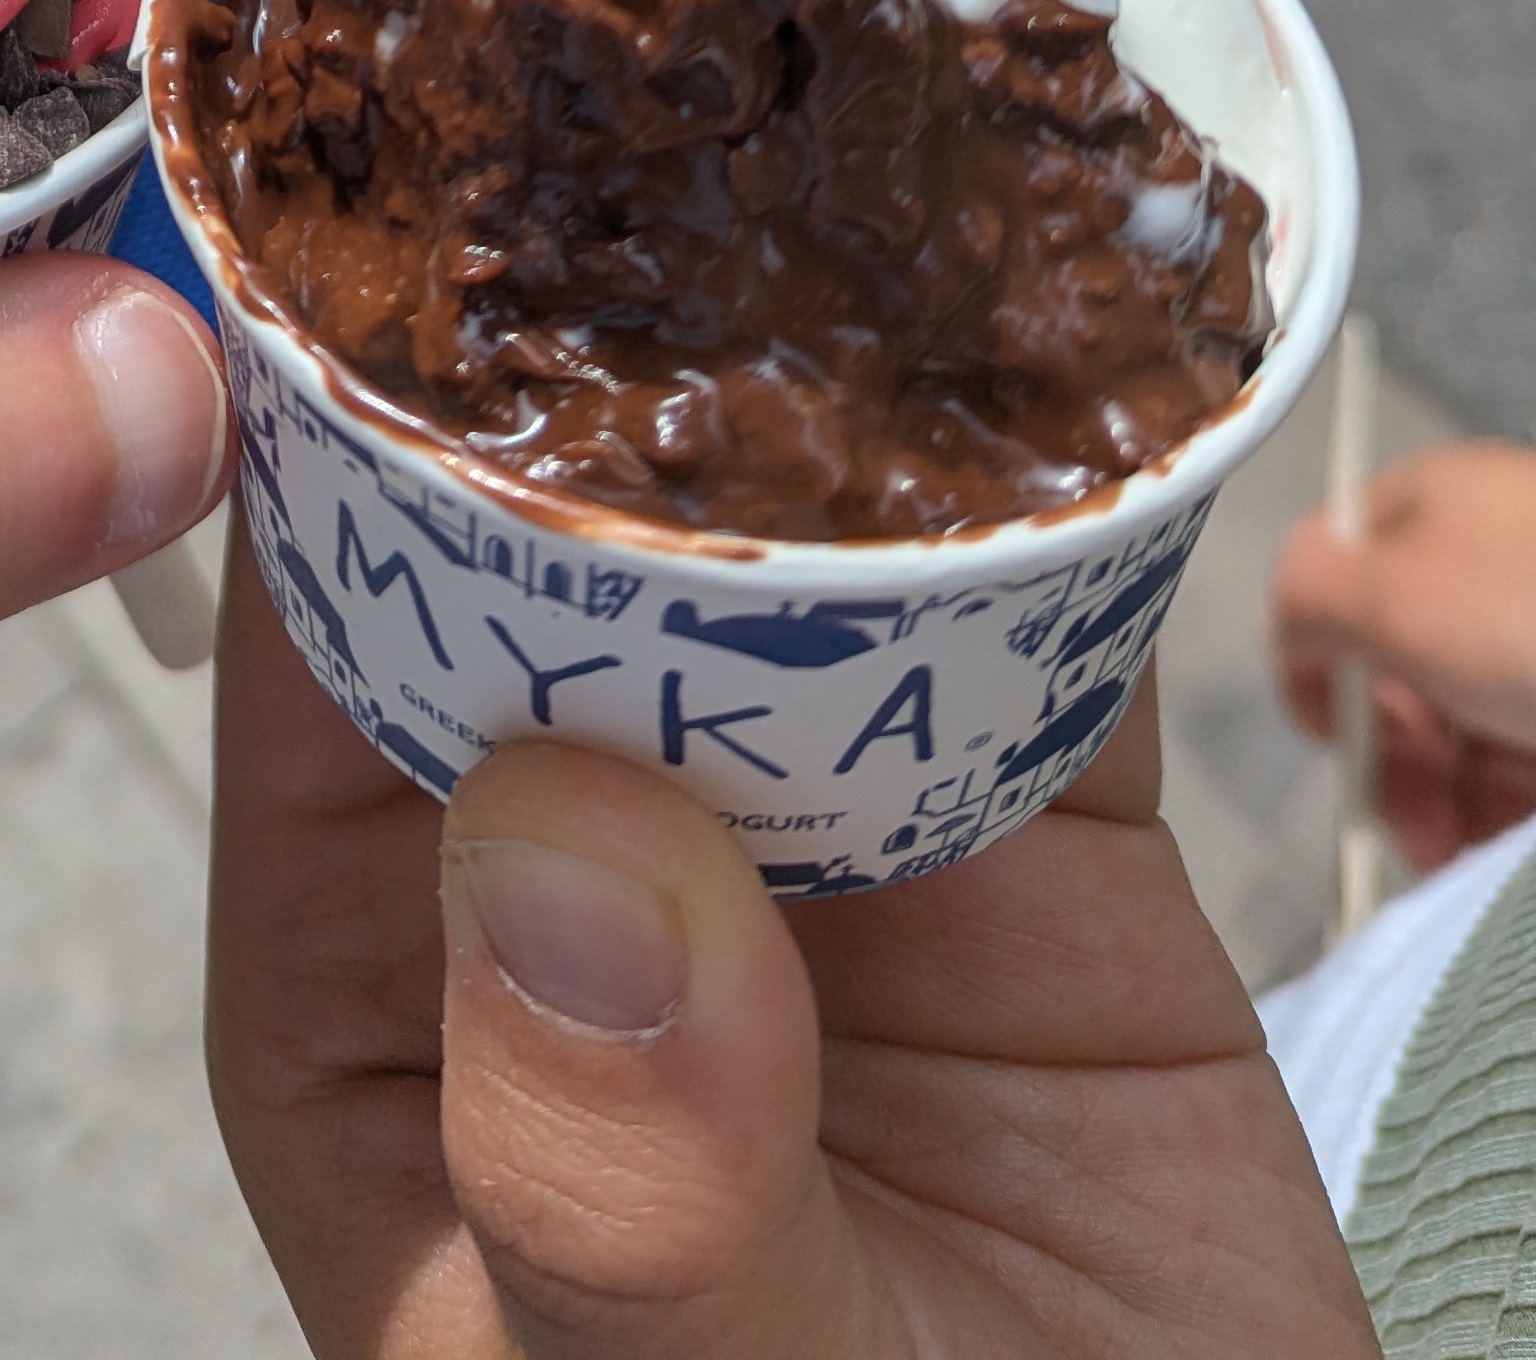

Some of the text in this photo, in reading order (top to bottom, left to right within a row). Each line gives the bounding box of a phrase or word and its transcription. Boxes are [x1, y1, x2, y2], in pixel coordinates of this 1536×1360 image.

[336, 497, 935, 781] MYKA
[399, 682, 849, 832] GREEK OGURT
